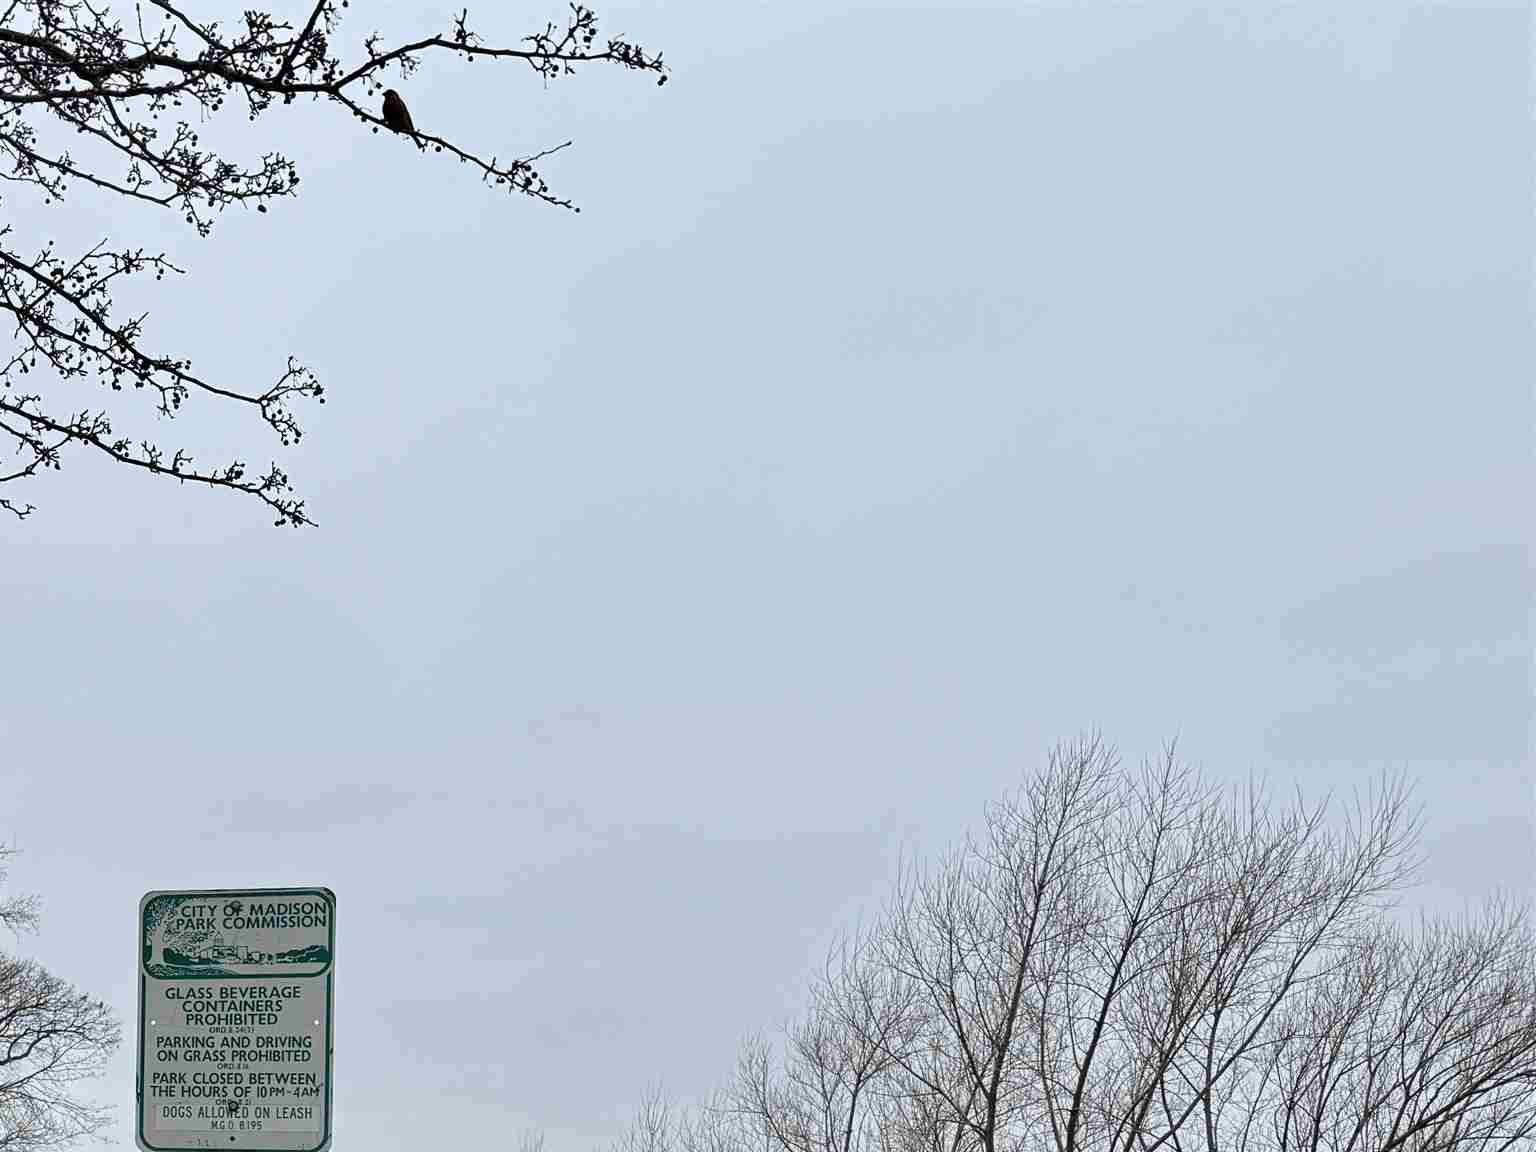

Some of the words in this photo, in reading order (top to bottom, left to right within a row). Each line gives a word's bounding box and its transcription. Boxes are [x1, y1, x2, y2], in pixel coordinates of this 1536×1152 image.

[181, 905, 217, 917] CITY
[223, 902, 243, 917] OF
[249, 902, 327, 915] MADISON
[176, 918, 216, 930] PARK
[223, 915, 327, 929] COMMISSION
[165, 987, 213, 1000] GLASS
[220, 986, 301, 999] BEVERAGE
[182, 1000, 282, 1013] CONTAINERS
[186, 1013, 278, 1025] PROHIBITED
[156, 1036, 215, 1048] PARKING
[220, 1036, 250, 1048] AND
[256, 1036, 312, 1048] DRIVING
[157, 1050, 178, 1062] ON
[183, 1050, 226, 1062] GRASS
[231, 1050, 311, 1062] PROHIBITED
[152, 1073, 186, 1085] PARK
[192, 1073, 243, 1085] CLOSED
[249, 1072, 316, 1085] BETWEEN
[150, 1086, 176, 1097] THE
[181, 1086, 228, 1097] HOURS
[234, 1086, 251, 1097] OF
[163, 1106, 192, 1118] DOGS
[198, 1106, 248, 1118] ALLOWED
[255, 1106, 270, 1118] ON
[276, 1106, 312, 1119] LEASH
